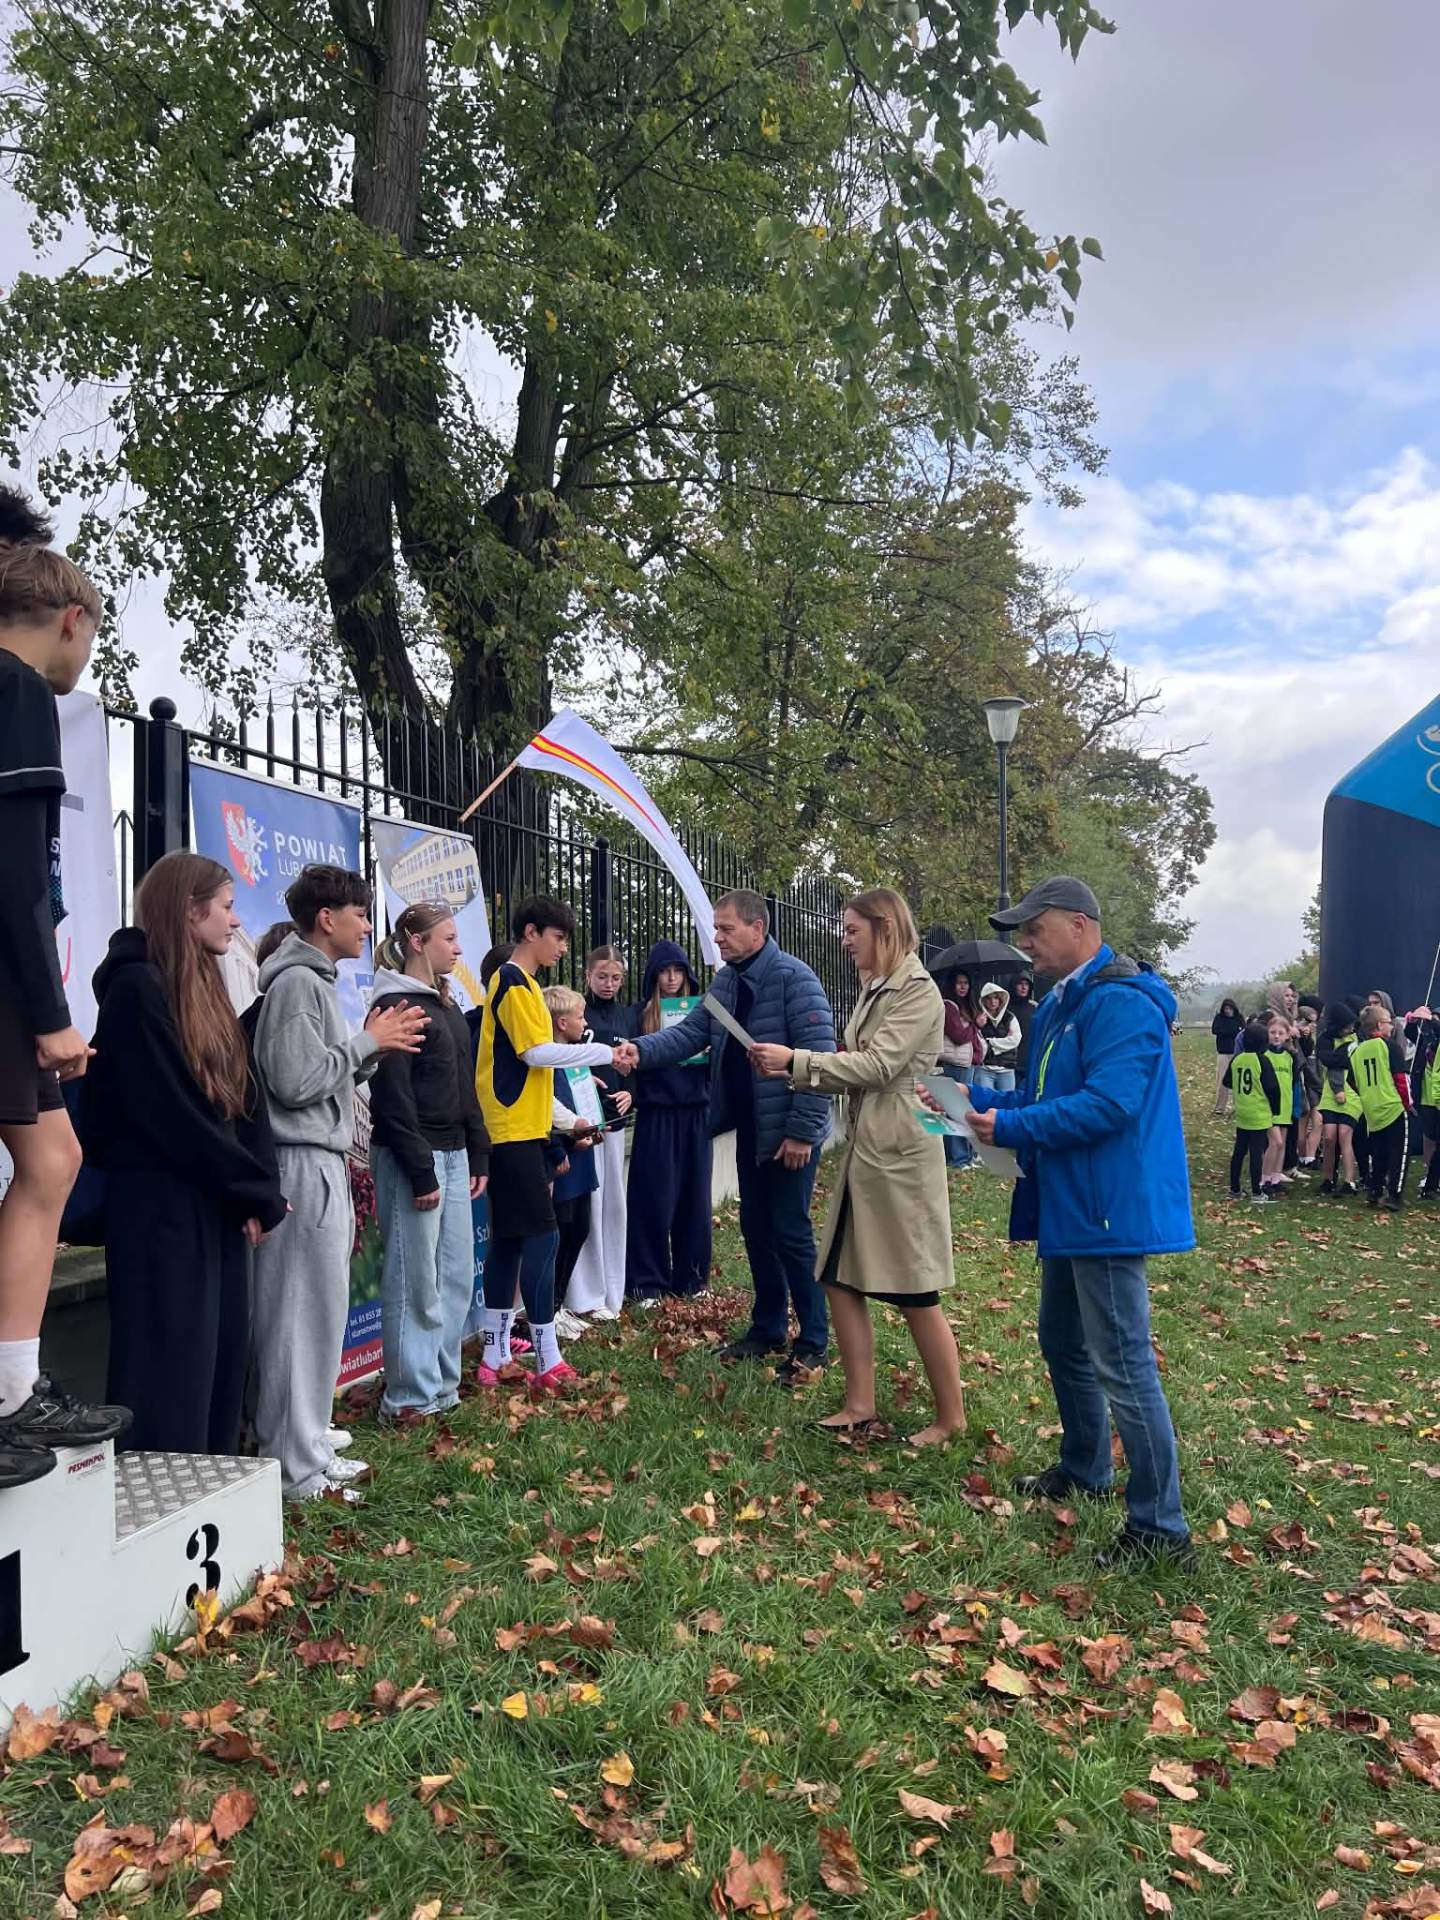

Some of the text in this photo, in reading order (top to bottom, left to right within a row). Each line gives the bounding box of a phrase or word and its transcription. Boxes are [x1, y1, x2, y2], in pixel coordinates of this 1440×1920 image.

[50, 836, 60, 853] S
[274, 831, 346, 866] POWIAT
[1237, 1067, 1253, 1096] 19
[1364, 1057, 1378, 1087] 11
[186, 1522, 221, 1610] 3
